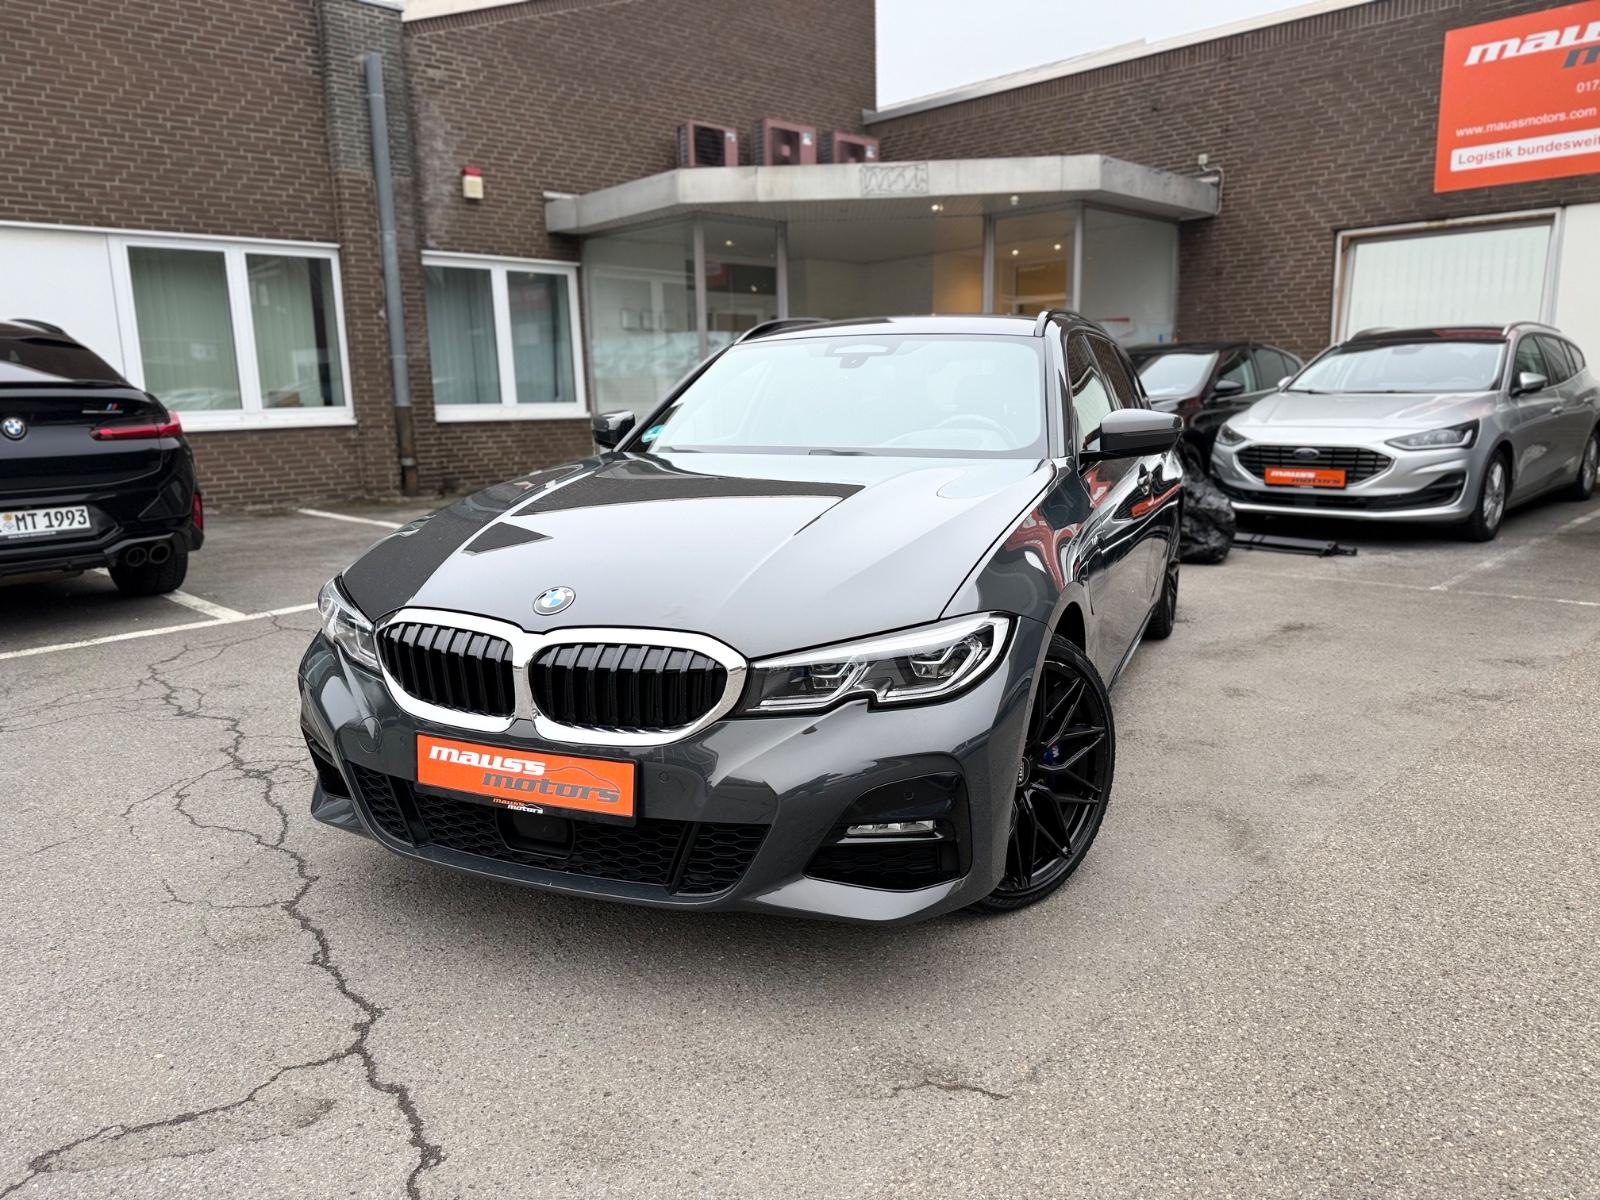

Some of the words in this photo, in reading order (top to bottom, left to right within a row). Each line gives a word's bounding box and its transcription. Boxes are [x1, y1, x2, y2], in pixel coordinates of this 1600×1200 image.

[1577, 79, 1600, 93] 017
[1456, 107, 1597, 137] www.maussmotors.com
[1457, 147, 1513, 165] Logistik
[14, 513, 37, 531] MT
[43, 509, 87, 528] 1993
[429, 744, 546, 776] mauss
[483, 772, 620, 803] motors
[507, 804, 544, 814] motors
